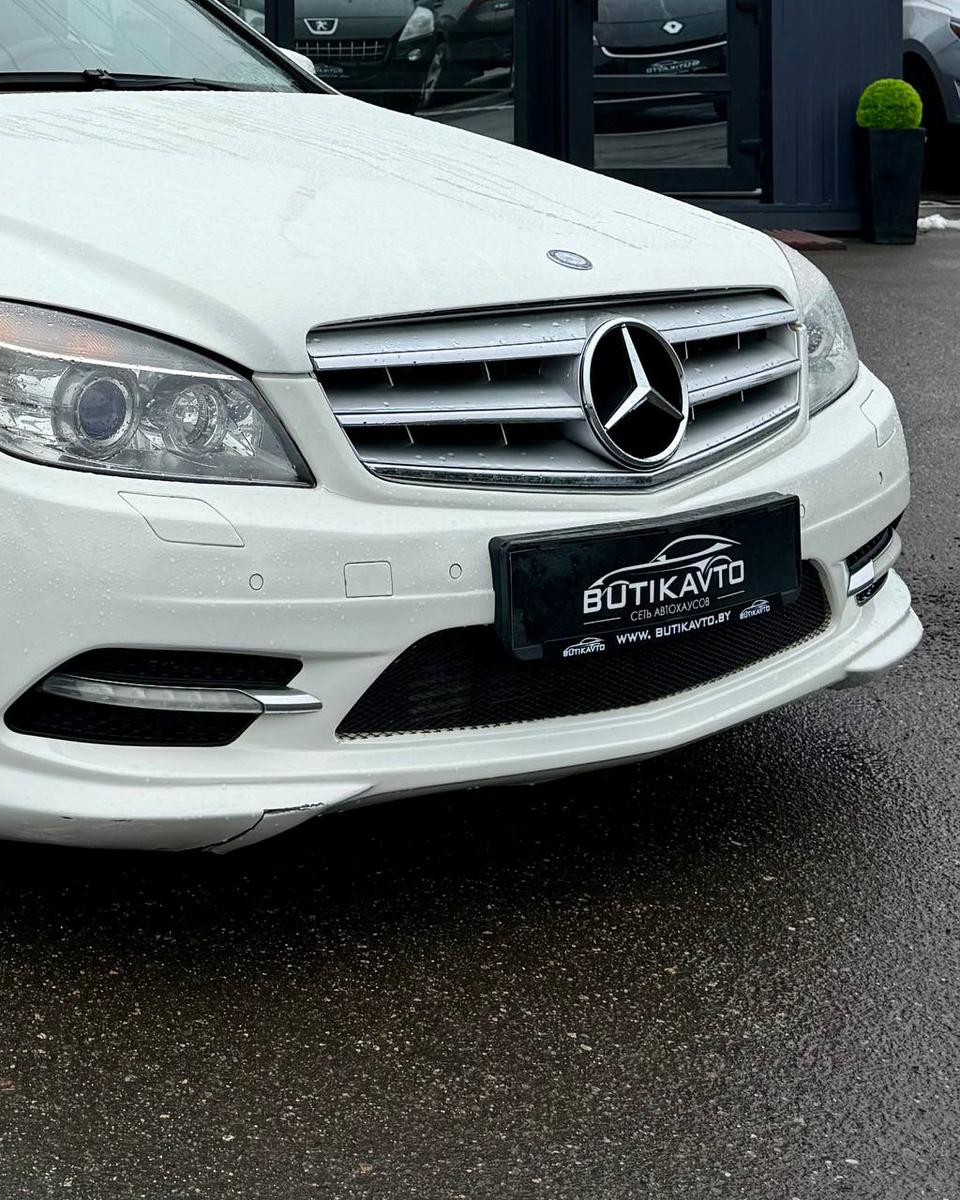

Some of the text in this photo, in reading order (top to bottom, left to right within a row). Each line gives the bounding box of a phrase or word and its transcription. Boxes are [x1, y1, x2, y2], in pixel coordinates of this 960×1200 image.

[583, 560, 745, 614] BUTIKAVTO
[630, 597, 710, 622] СЕТЬ АВТОХАУСОВ
[739, 605, 770, 620] BUTIKAVTO
[616, 611, 731, 645] WWW. BUTIKAVTO.BY
[563, 644, 605, 657] BUTIKAVTO
